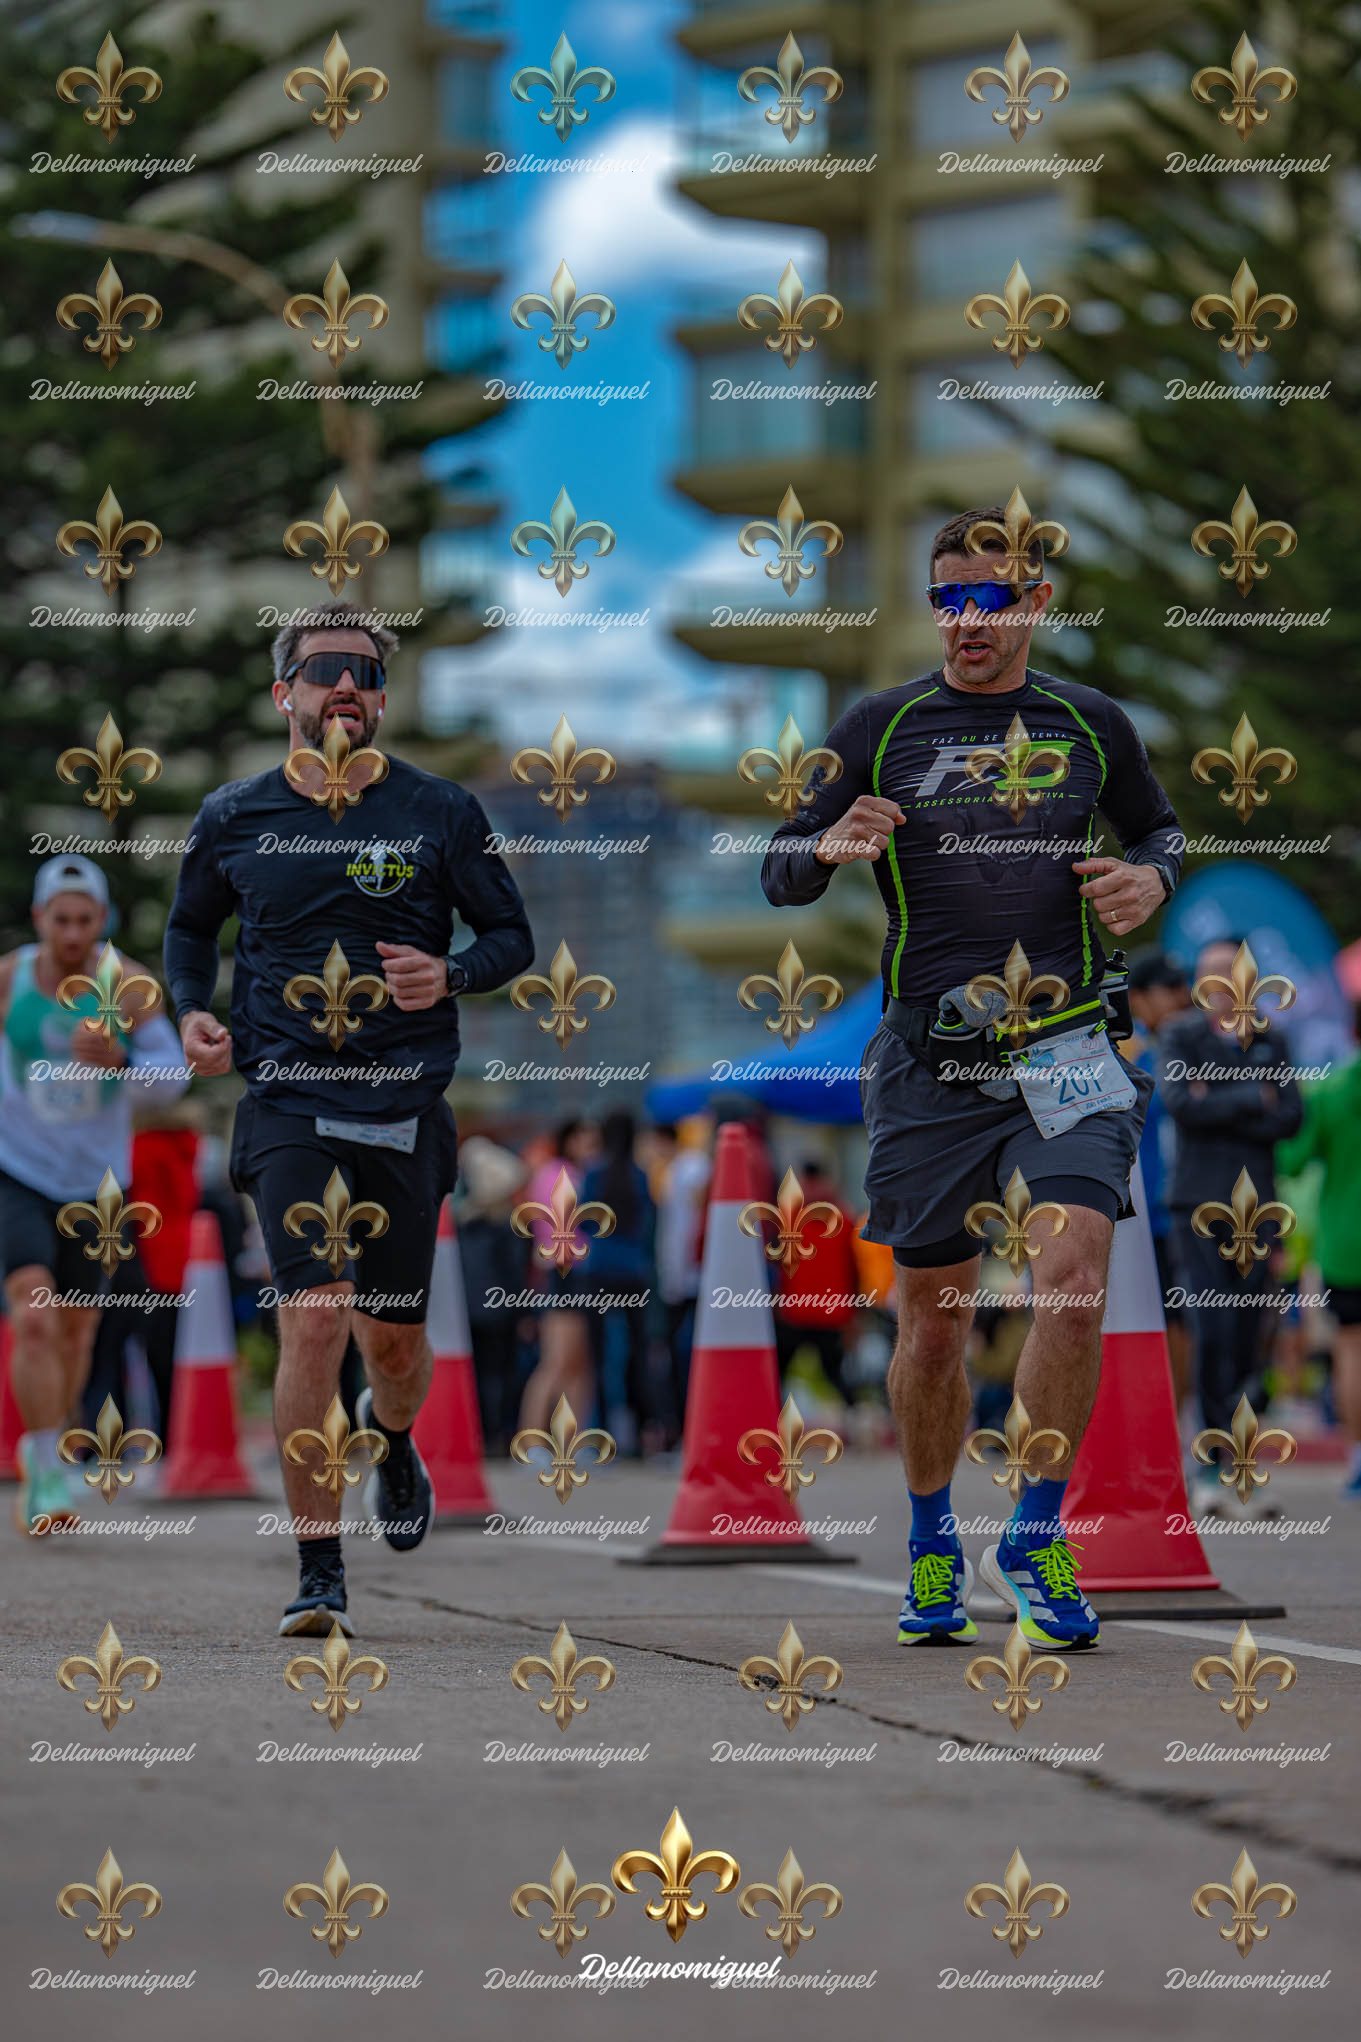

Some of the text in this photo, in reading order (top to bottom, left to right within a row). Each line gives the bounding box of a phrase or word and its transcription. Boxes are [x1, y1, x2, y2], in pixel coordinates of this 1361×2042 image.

[931, 736, 954, 745] FAZ
[961, 735, 977, 743] OU
[983, 734, 998, 742] SE
[915, 795, 994, 809] ASSESSORIA
[346, 863, 415, 879] INVICTUS
[1050, 1063, 1102, 1106] 201
